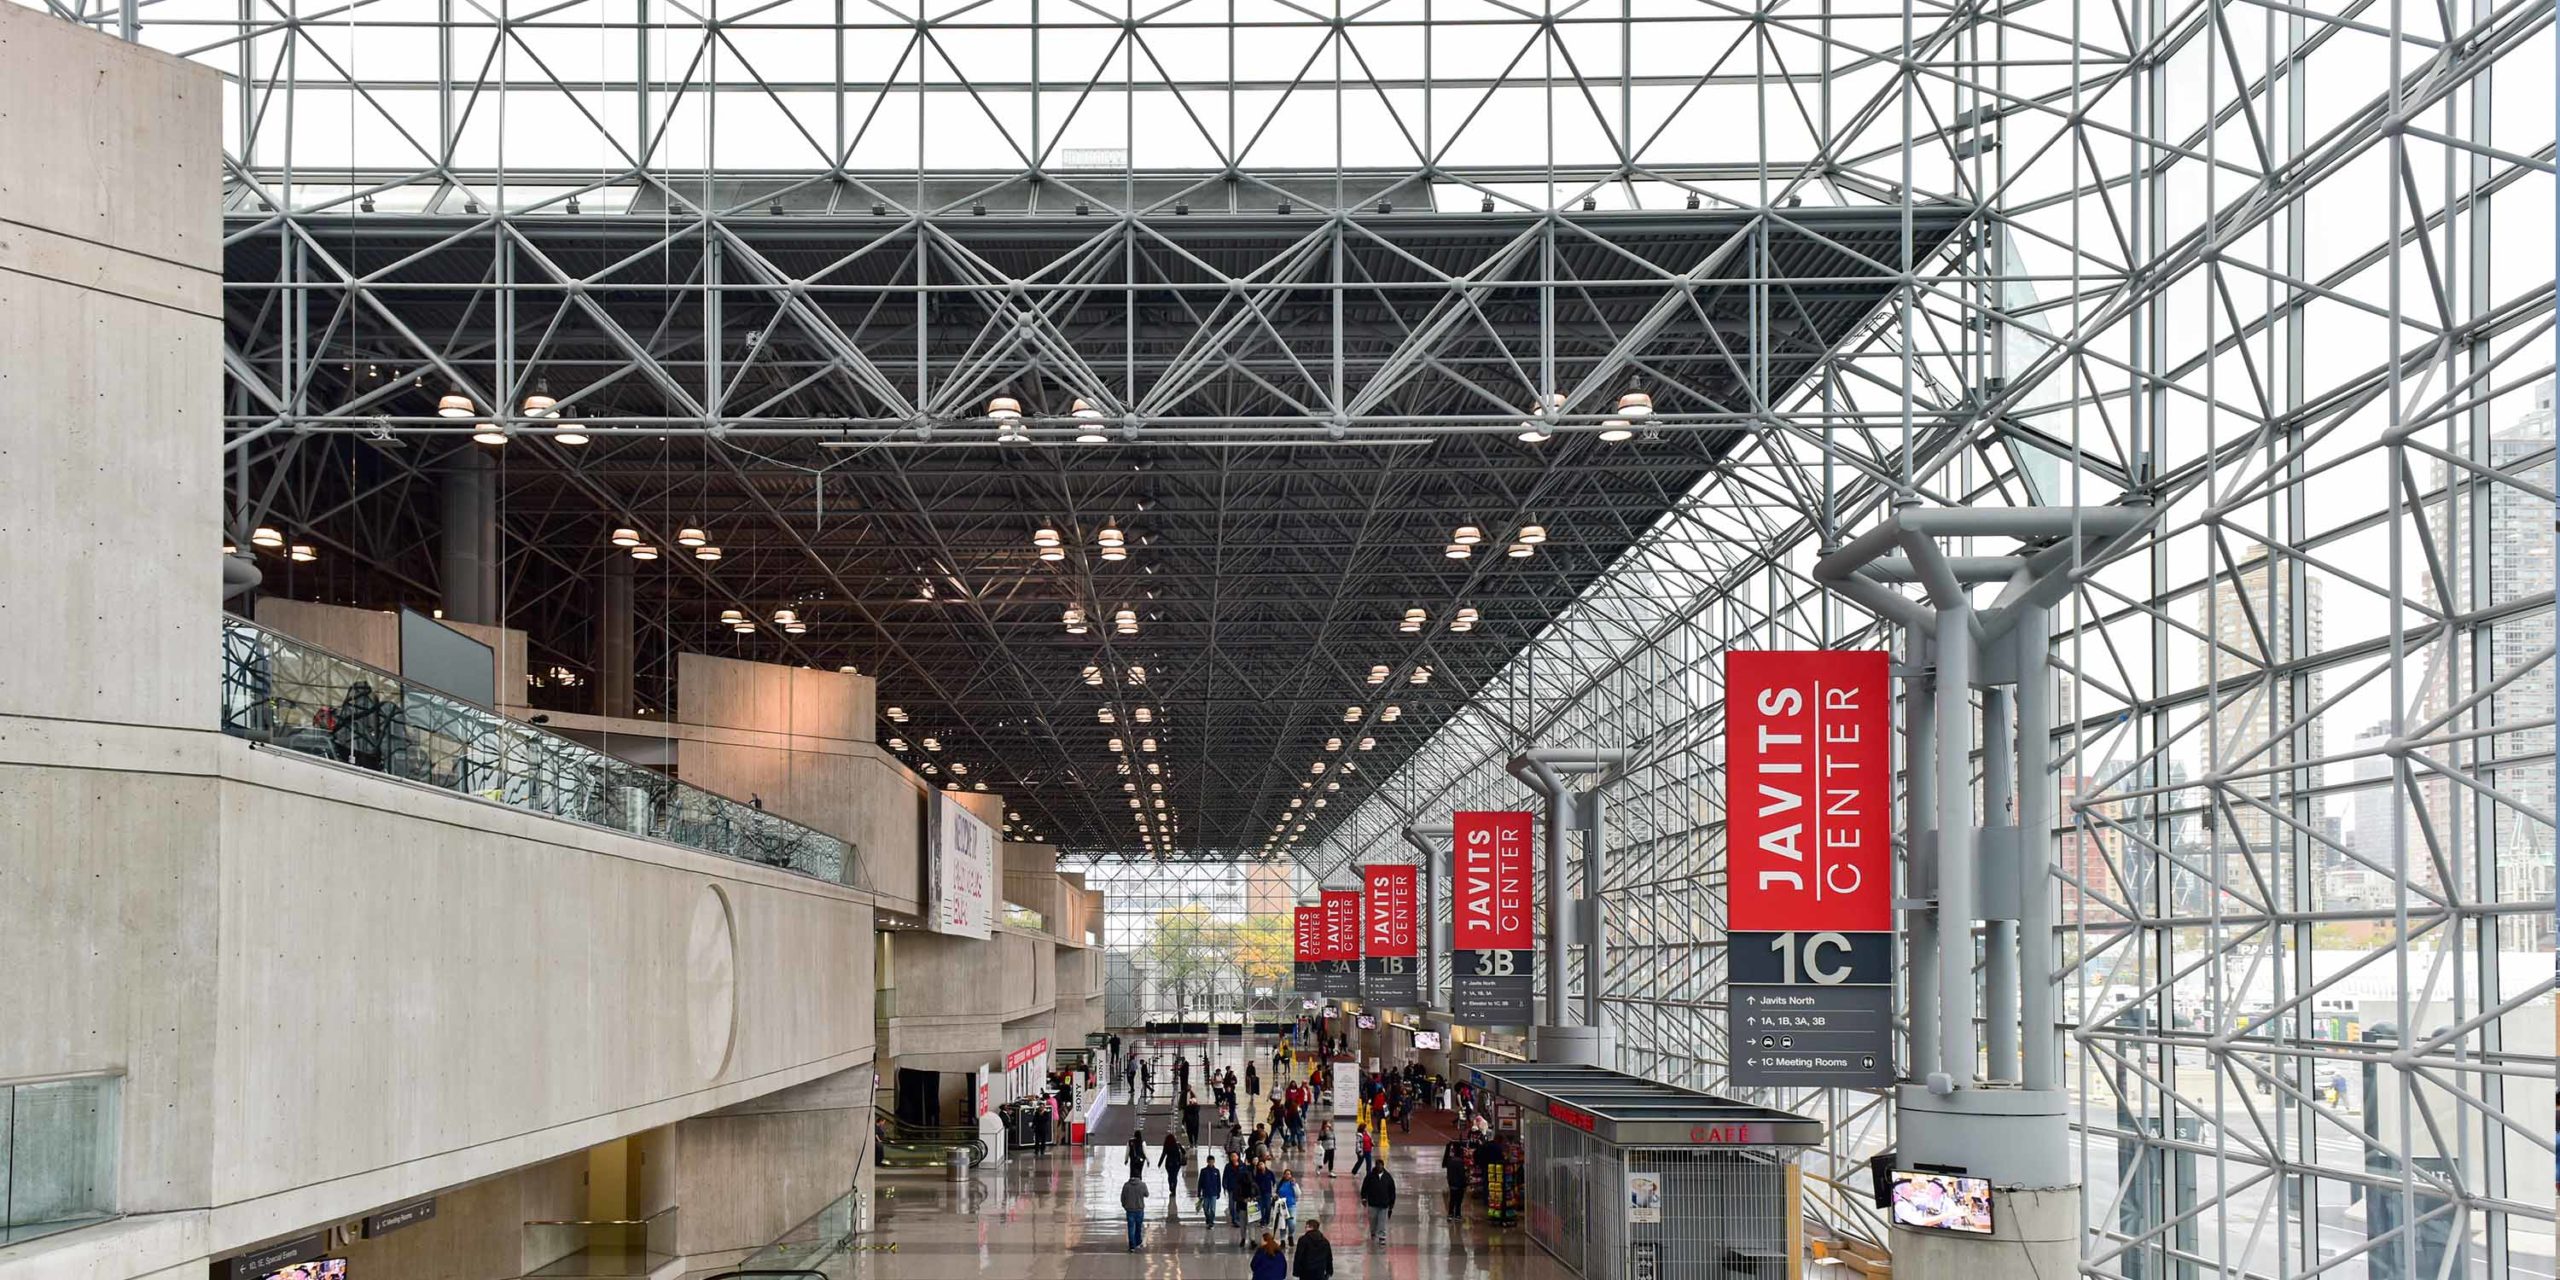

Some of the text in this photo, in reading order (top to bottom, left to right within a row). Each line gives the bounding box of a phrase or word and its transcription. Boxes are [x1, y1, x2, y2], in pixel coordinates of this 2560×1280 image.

[1757, 687, 1804, 891] JAVITS
[1826, 687, 1862, 894] CENTER
[1467, 830, 1491, 930] JAVITS
[1502, 829, 1519, 932] CENTER
[1299, 913, 1310, 954] JAVITS
[1327, 900, 1340, 951] JAVITS
[1343, 899, 1354, 951] CENTER
[1374, 877, 1390, 944] JAVITS
[1395, 876, 1408, 945] CENTER
[1312, 913, 1321, 955] CENTER
[1330, 960, 1351, 973] 3A
[1380, 957, 1404, 974] 1B
[1475, 950, 1515, 975] 3B
[1771, 932, 1853, 984] 1C
[1760, 996, 1815, 1005] Javits North
[1761, 1017, 1826, 1027] 1A, 1B, 3A, 3B
[1761, 1058, 1848, 1068] 1C Meeting Rooms
[1691, 1124, 1750, 1143] CAFÉ
